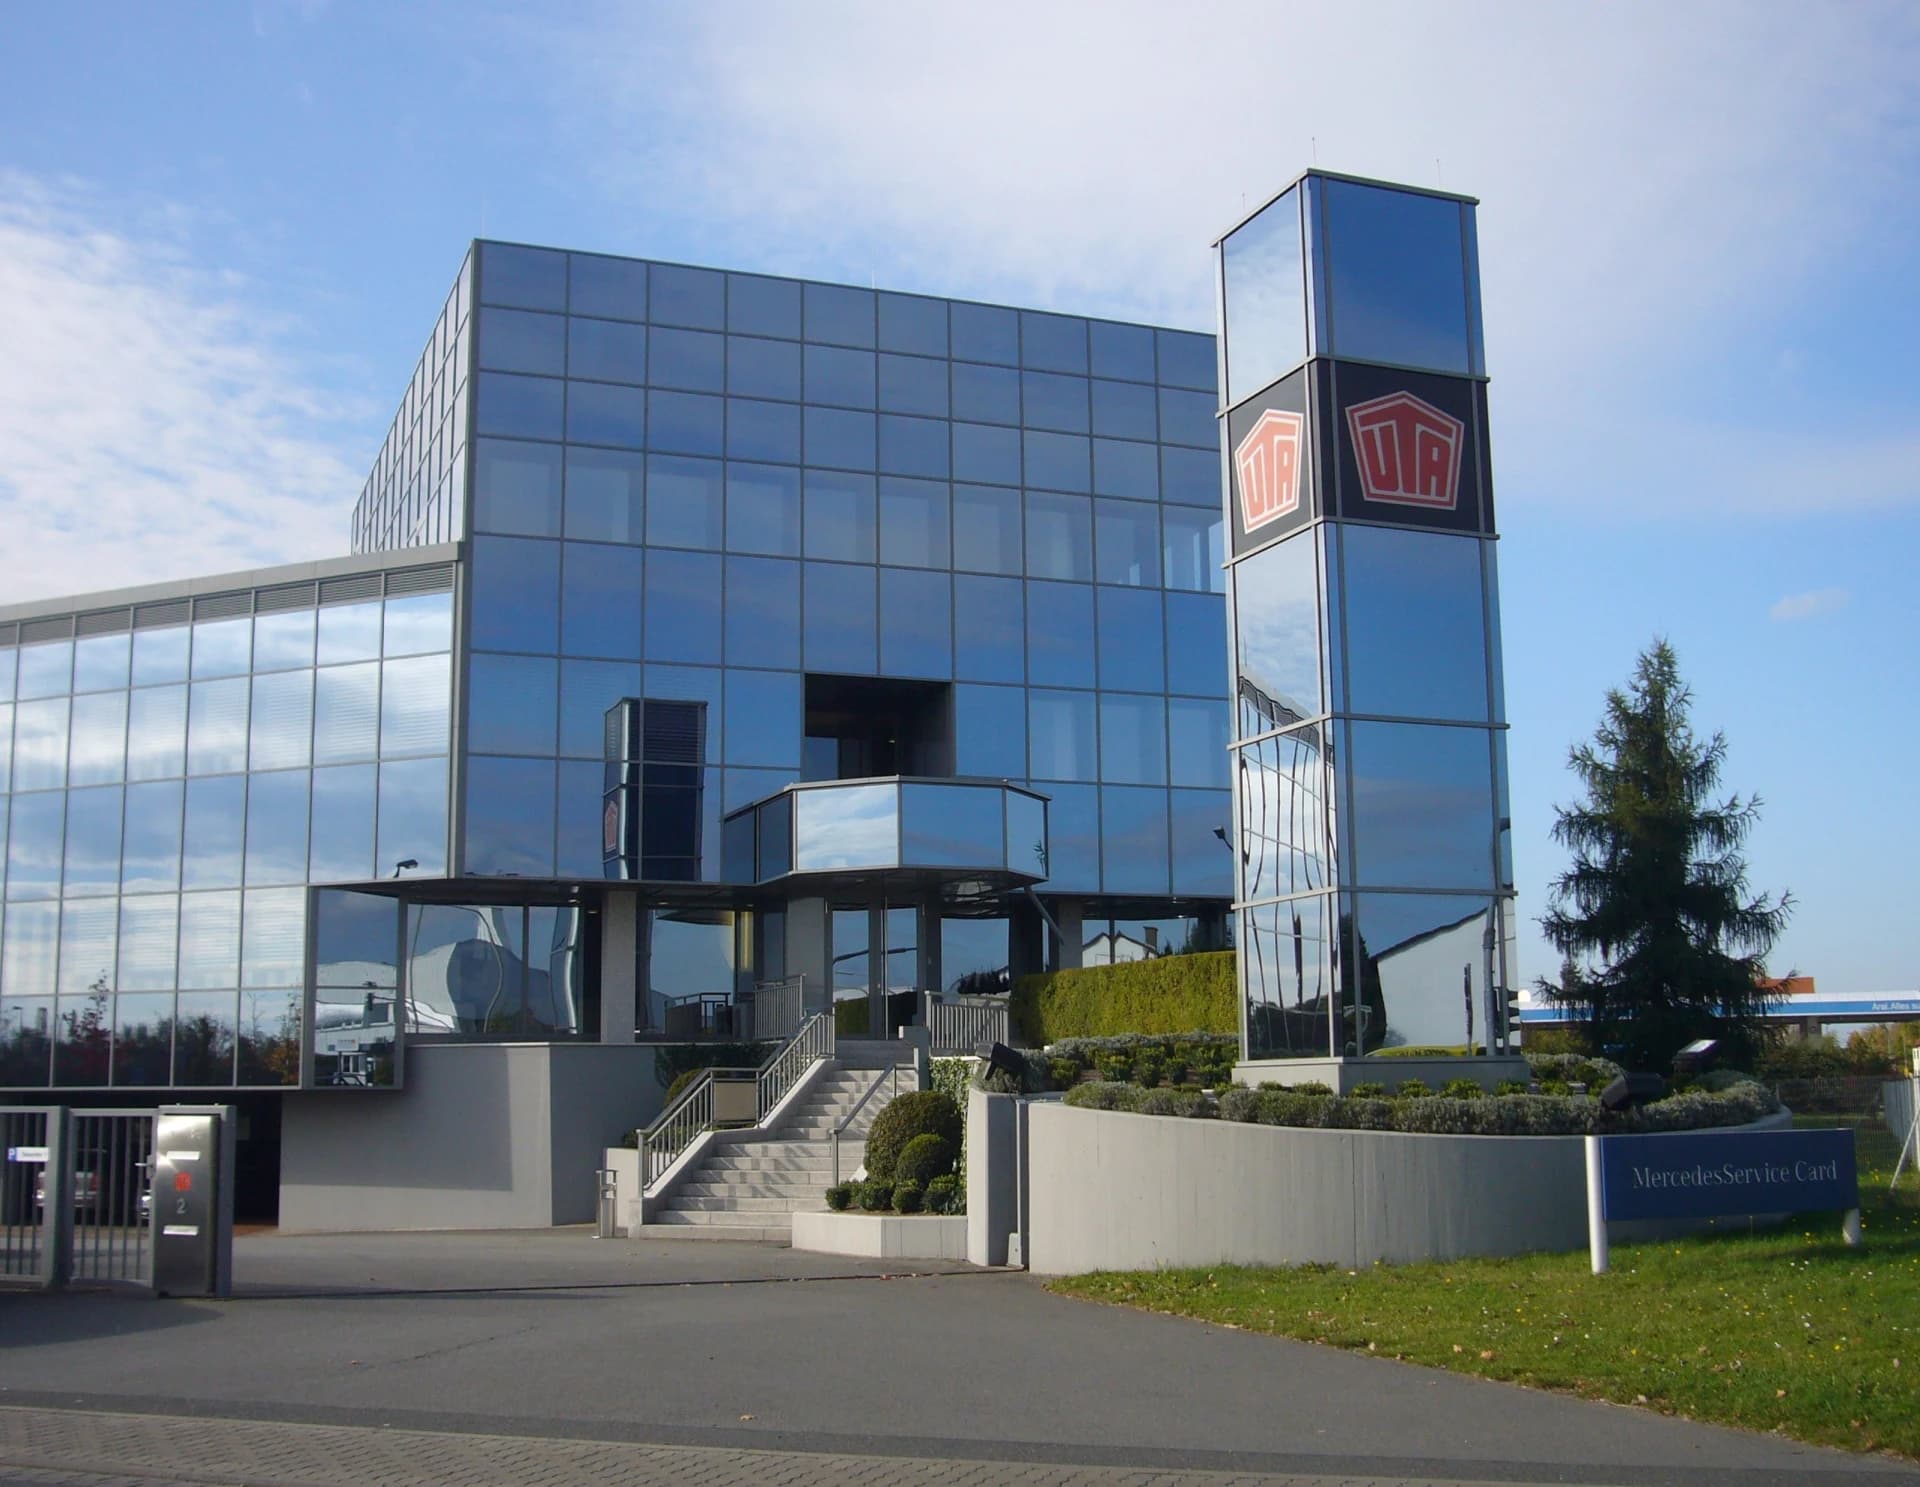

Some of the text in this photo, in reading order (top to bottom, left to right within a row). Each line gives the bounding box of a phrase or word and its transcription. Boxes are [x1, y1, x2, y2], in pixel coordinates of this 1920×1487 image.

[1237, 413, 1301, 525] UTA
[1353, 397, 1458, 502] UTA
[176, 1198, 187, 1214] 2
